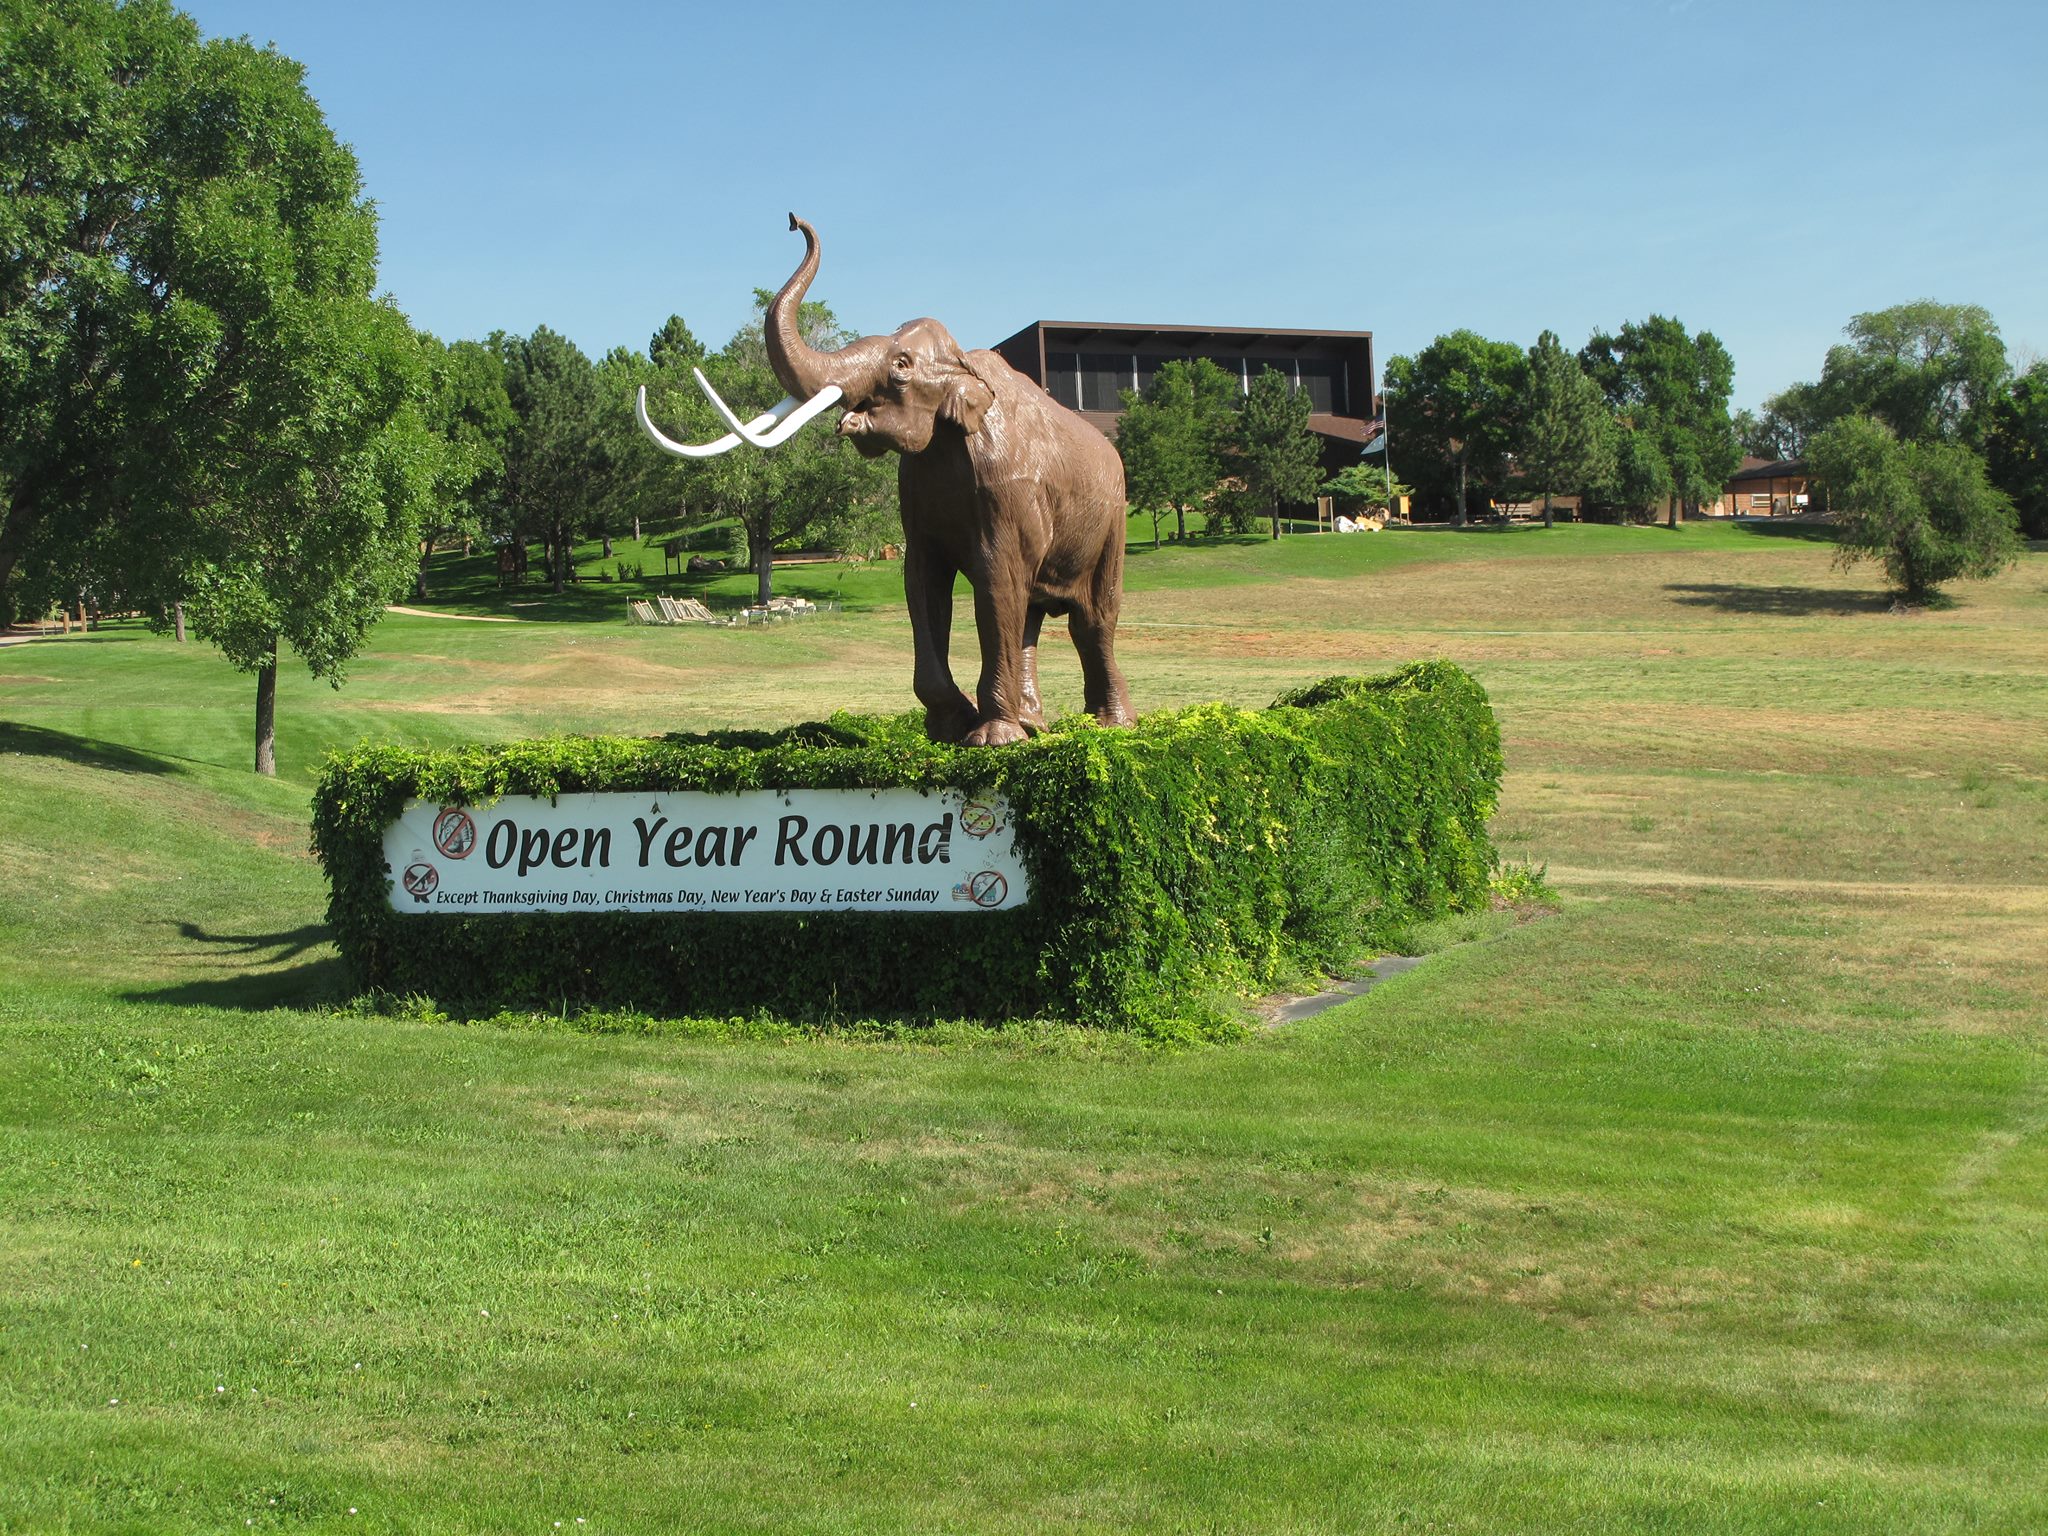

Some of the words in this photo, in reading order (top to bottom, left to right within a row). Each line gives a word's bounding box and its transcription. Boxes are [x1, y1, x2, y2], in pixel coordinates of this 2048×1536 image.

[485, 818, 611, 877] Open
[632, 816, 757, 867] Year
[774, 812, 954, 866] Round
[436, 890, 479, 906] Except
[482, 889, 568, 906] Thanksgiving
[572, 890, 600, 906] Day,
[604, 889, 673, 904] Christmas
[677, 889, 707, 906] Day,
[711, 889, 742, 903] New
[744, 889, 786, 903] Year's
[790, 889, 816, 905] Day
[820, 889, 831, 904] &
[836, 888, 883, 903] Easter
[886, 888, 940, 904] Sunday
